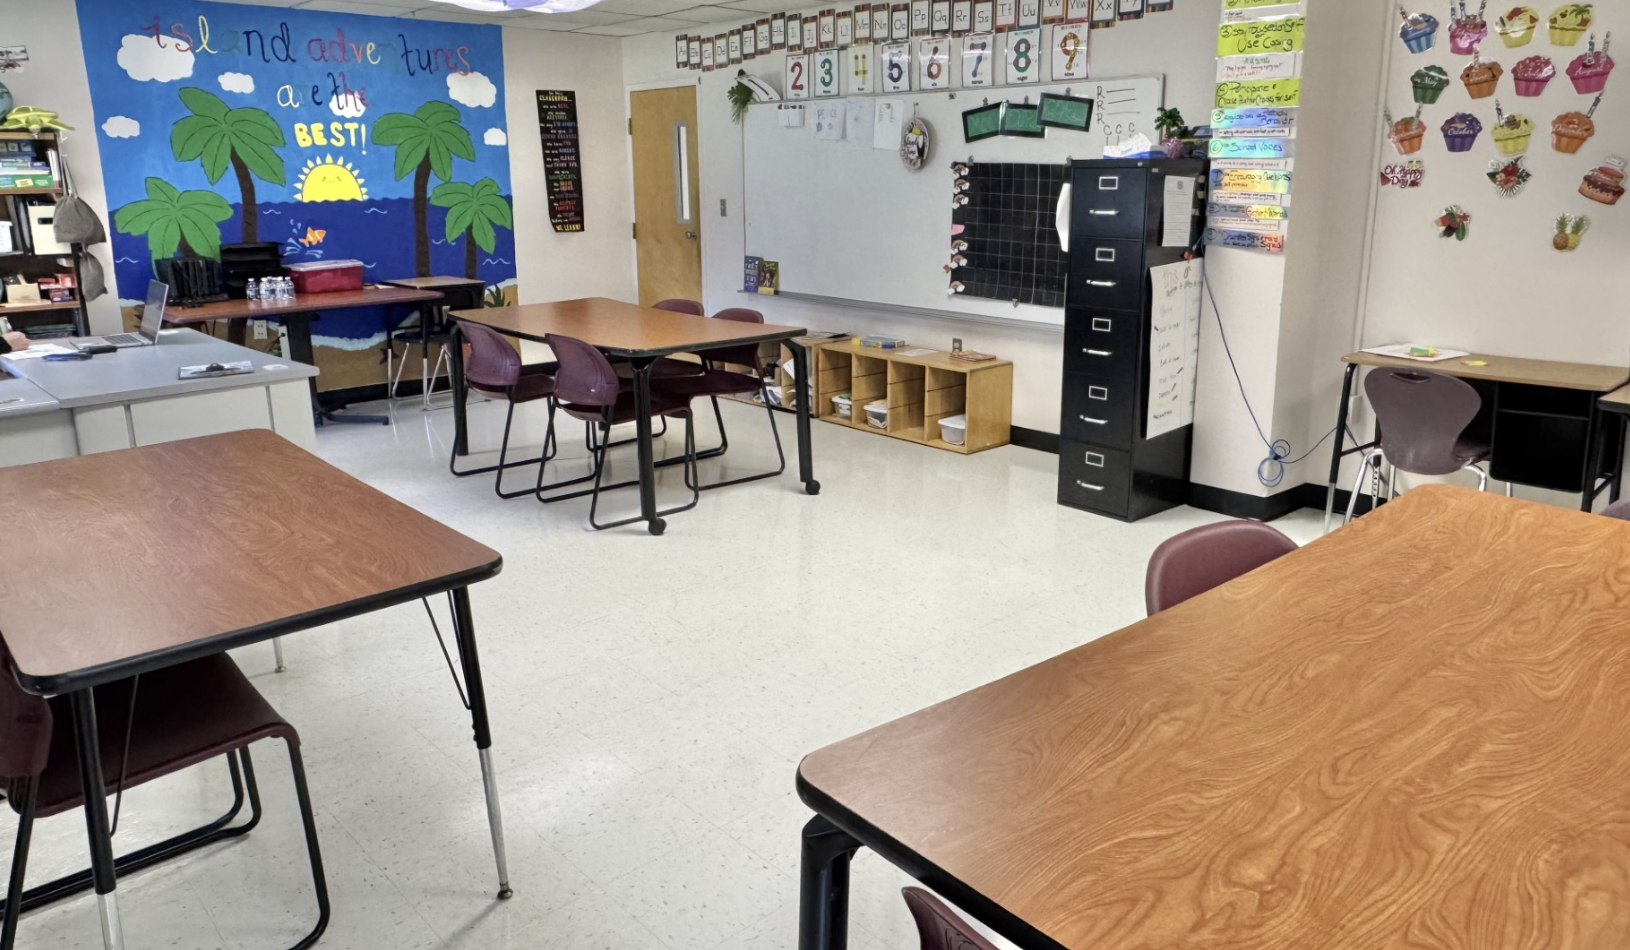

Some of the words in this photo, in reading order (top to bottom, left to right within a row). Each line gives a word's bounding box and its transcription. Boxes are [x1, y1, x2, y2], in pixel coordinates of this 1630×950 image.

[914, 9, 927, 24] Pp
[955, 10, 967, 22] Rr
[977, 10, 989, 23] Ss
[1022, 4, 1036, 17] Uu
[140, 14, 297, 63] island
[1060, 32, 1080, 71] 9
[854, 54, 869, 85] 4
[888, 51, 903, 83] 5
[927, 46, 941, 80] 6
[969, 41, 987, 78] 7
[1013, 38, 1031, 73] 8
[791, 61, 803, 90] 2
[820, 58, 833, 87] 3
[327, 72, 370, 112] the
[294, 122, 367, 155] BEST!
[1447, 127, 1473, 136] October
[1390, 175, 1408, 188] Day
[1399, 164, 1423, 180] Happy
